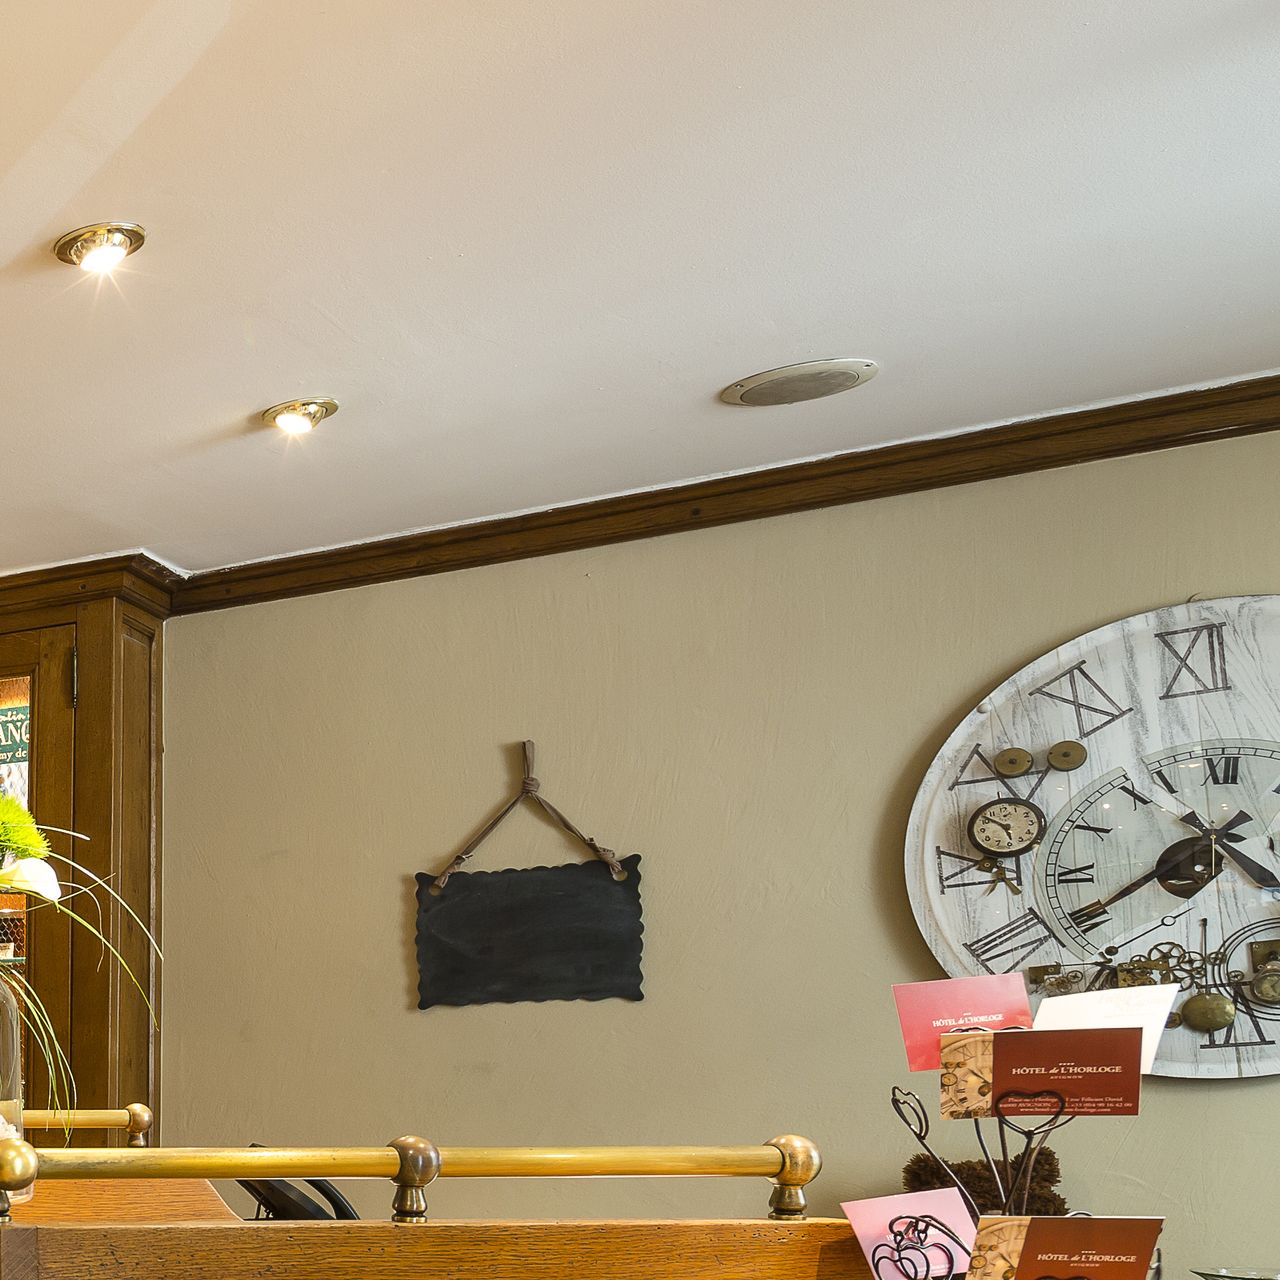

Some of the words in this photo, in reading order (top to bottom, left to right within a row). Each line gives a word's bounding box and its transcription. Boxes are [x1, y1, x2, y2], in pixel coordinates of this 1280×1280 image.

[1153, 621, 1232, 701] XII
[1028, 659, 1134, 741] XI
[1200, 755, 1242, 787] XII
[932, 1018, 957, 1028] HÔTEL
[1011, 1066, 1047, 1075] HÔTEL
[1048, 1066, 1060, 1074] de
[1060, 1065, 1123, 1074] L'HORLOGE
[1037, 1253, 1070, 1261] HÔTEL
[1081, 1254, 1137, 1263] L'HORLOGE
